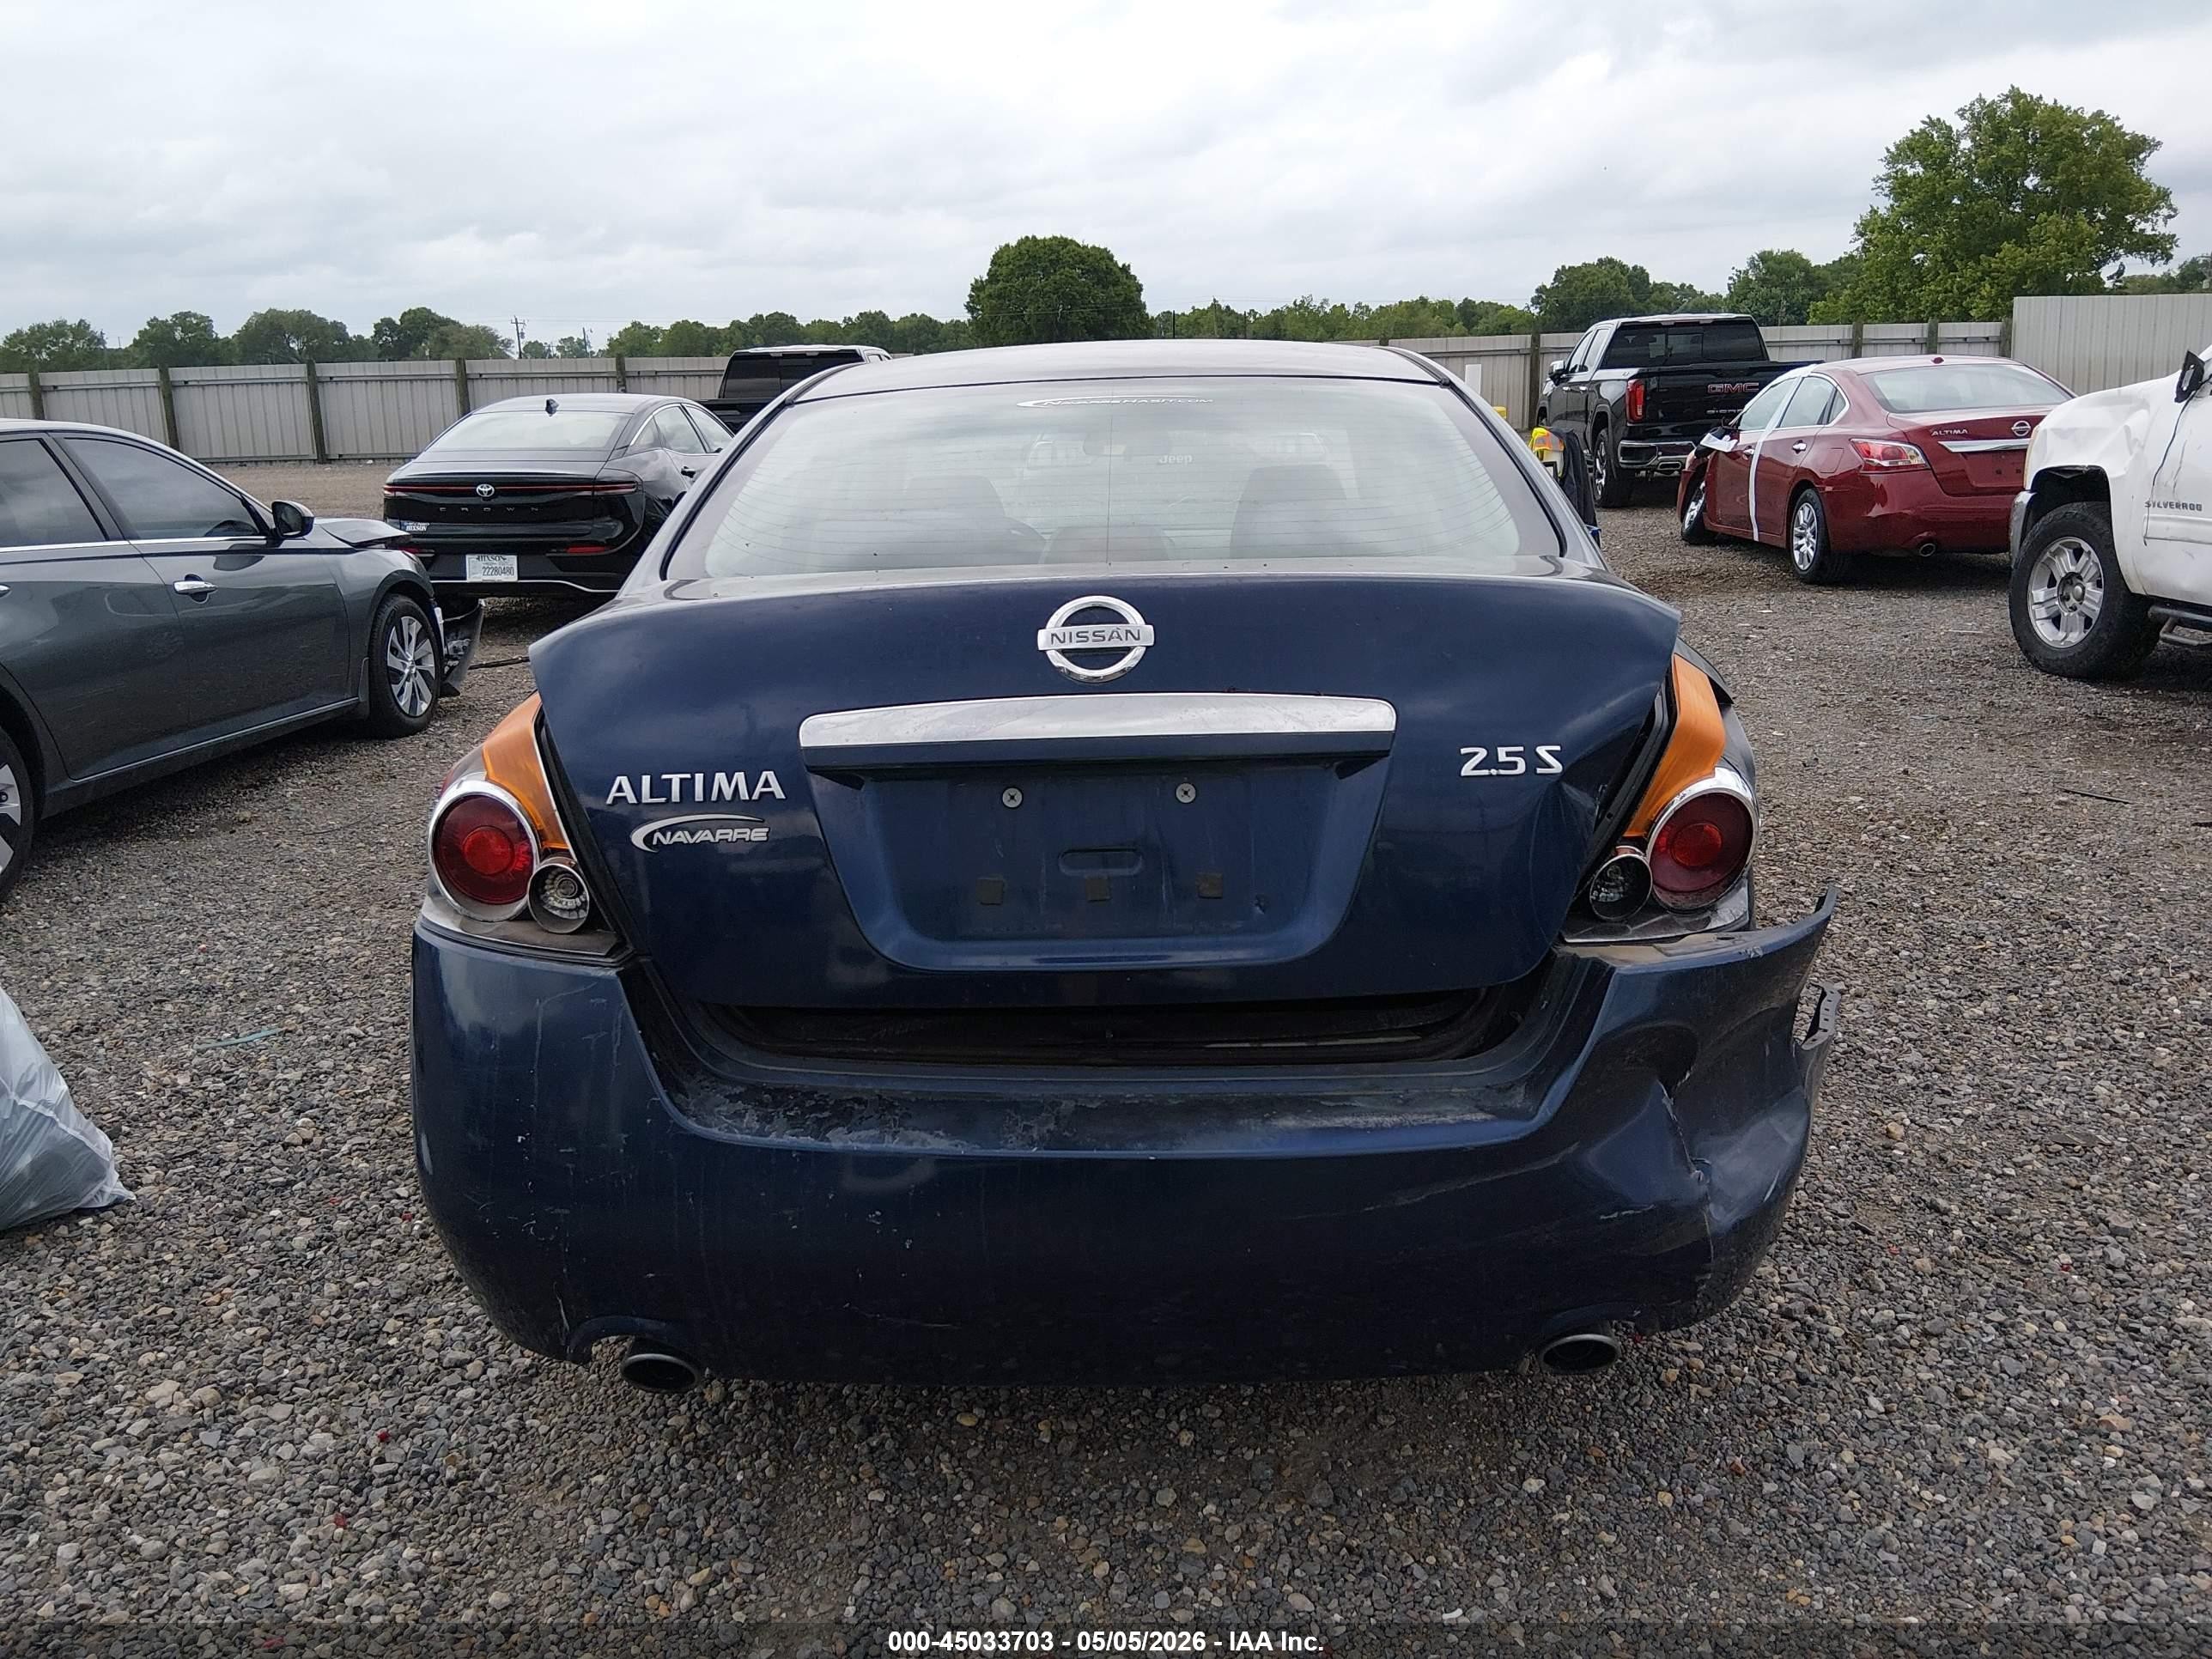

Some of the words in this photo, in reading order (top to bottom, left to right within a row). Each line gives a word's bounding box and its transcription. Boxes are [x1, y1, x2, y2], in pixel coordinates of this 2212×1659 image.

[1708, 382, 1759, 393] GMC
[1158, 454, 1193, 466] Jeep
[2144, 501, 2203, 512] SILVERADO
[1050, 629, 1141, 645] NISSAN
[1460, 746, 1526, 777] 2.5
[1535, 745, 1564, 775] S
[605, 771, 787, 805] ALTIMA
[652, 827, 770, 845] NAVARRE
